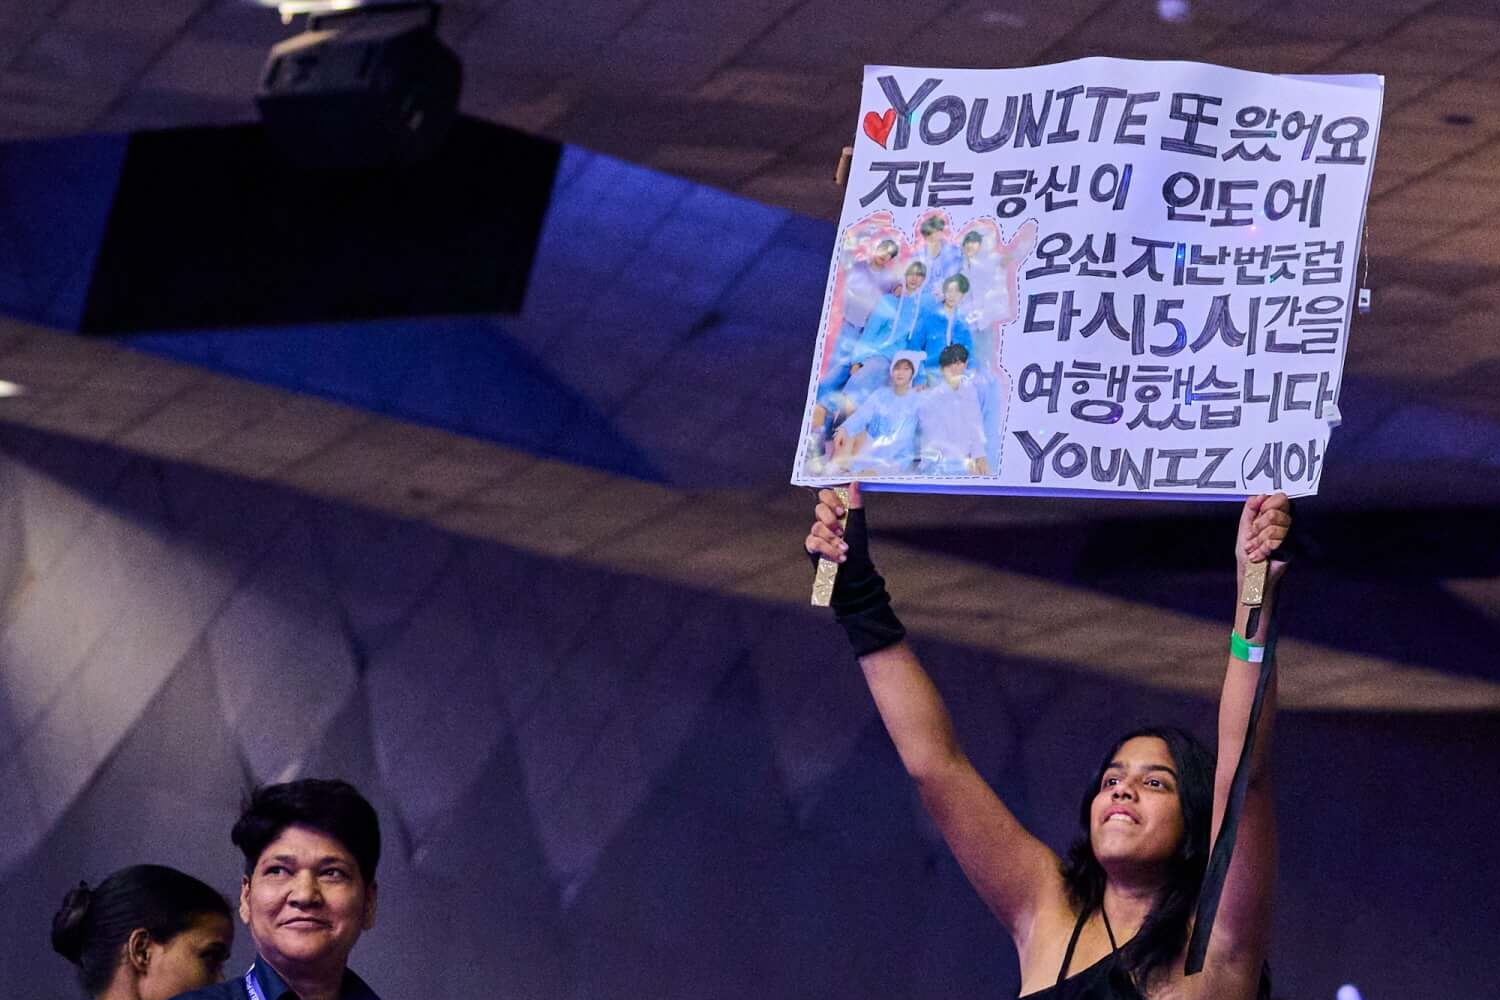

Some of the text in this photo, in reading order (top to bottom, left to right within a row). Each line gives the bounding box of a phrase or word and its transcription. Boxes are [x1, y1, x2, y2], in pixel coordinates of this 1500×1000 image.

[876, 75, 1161, 153] YOUNITE
[1160, 92, 1223, 159] 또
[859, 160, 975, 208] 저는
[1162, 171, 1327, 229] 인도에
[1025, 231, 1117, 280] 오신
[1017, 359, 1334, 431] 여행했습니다
[1012, 430, 1237, 491] YOUNIZ
